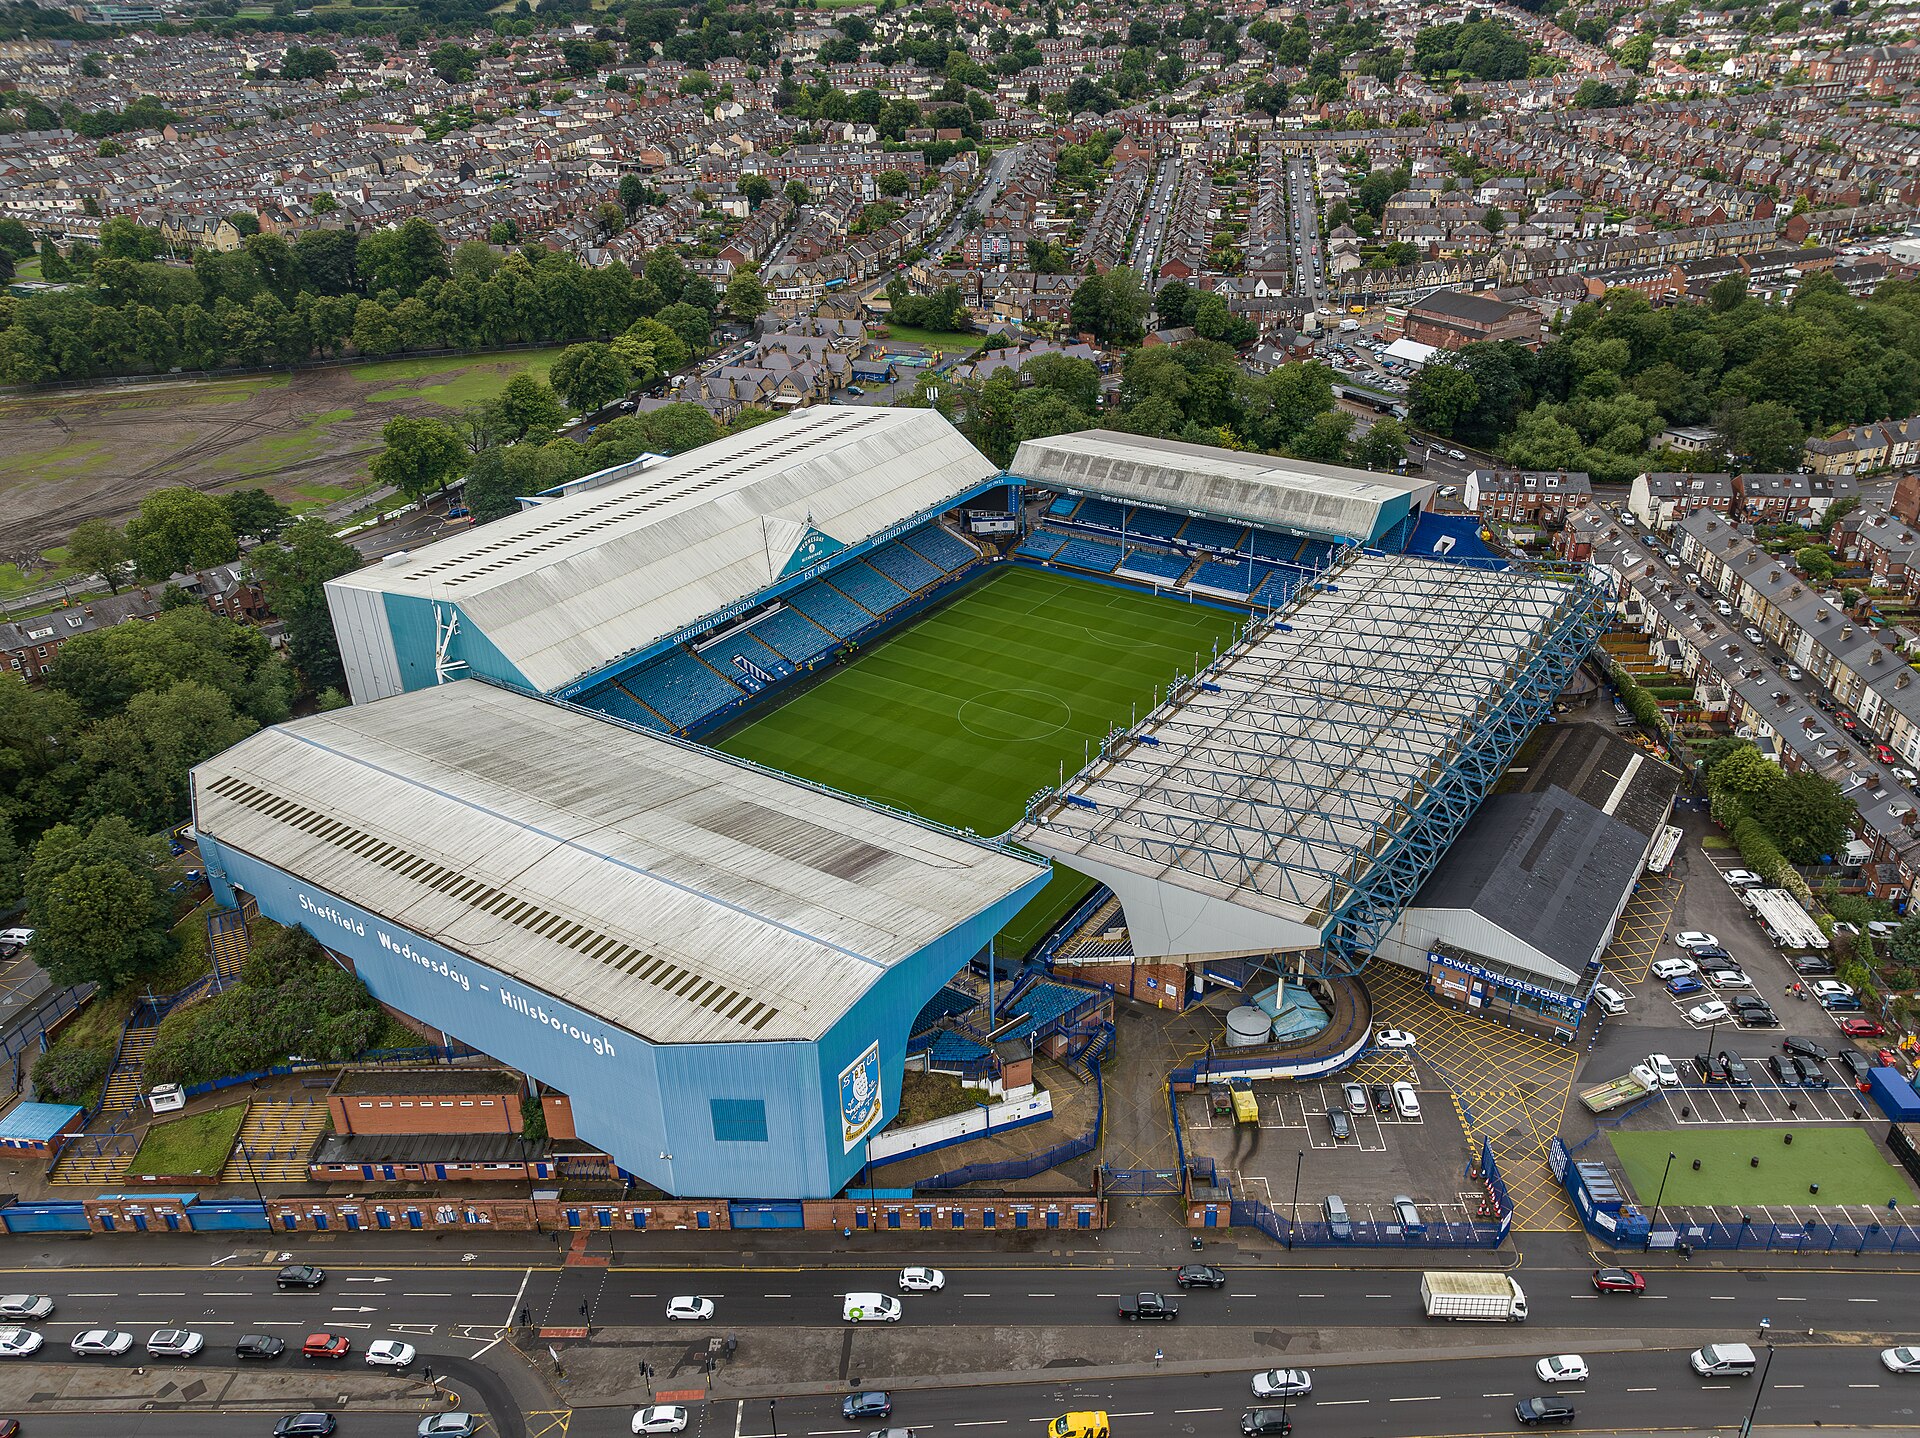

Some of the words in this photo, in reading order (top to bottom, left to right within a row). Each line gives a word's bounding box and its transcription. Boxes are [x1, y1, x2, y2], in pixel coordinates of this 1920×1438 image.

[871, 528, 901, 547] SHEFFIELD
[901, 511, 934, 533] WEDNESDAY
[817, 562, 831, 574] 1867
[672, 620, 712, 645] SHEFFIELD
[712, 598, 757, 625] WEDNESDAY
[565, 685, 581, 697] OWLS
[298, 893, 366, 938] Sheffield
[377, 930, 471, 992] Wednesday
[500, 988, 616, 1058] Hillsborough
[1443, 957, 1481, 975] OWLS
[1484, 971, 1568, 1003] MEGASTORE
